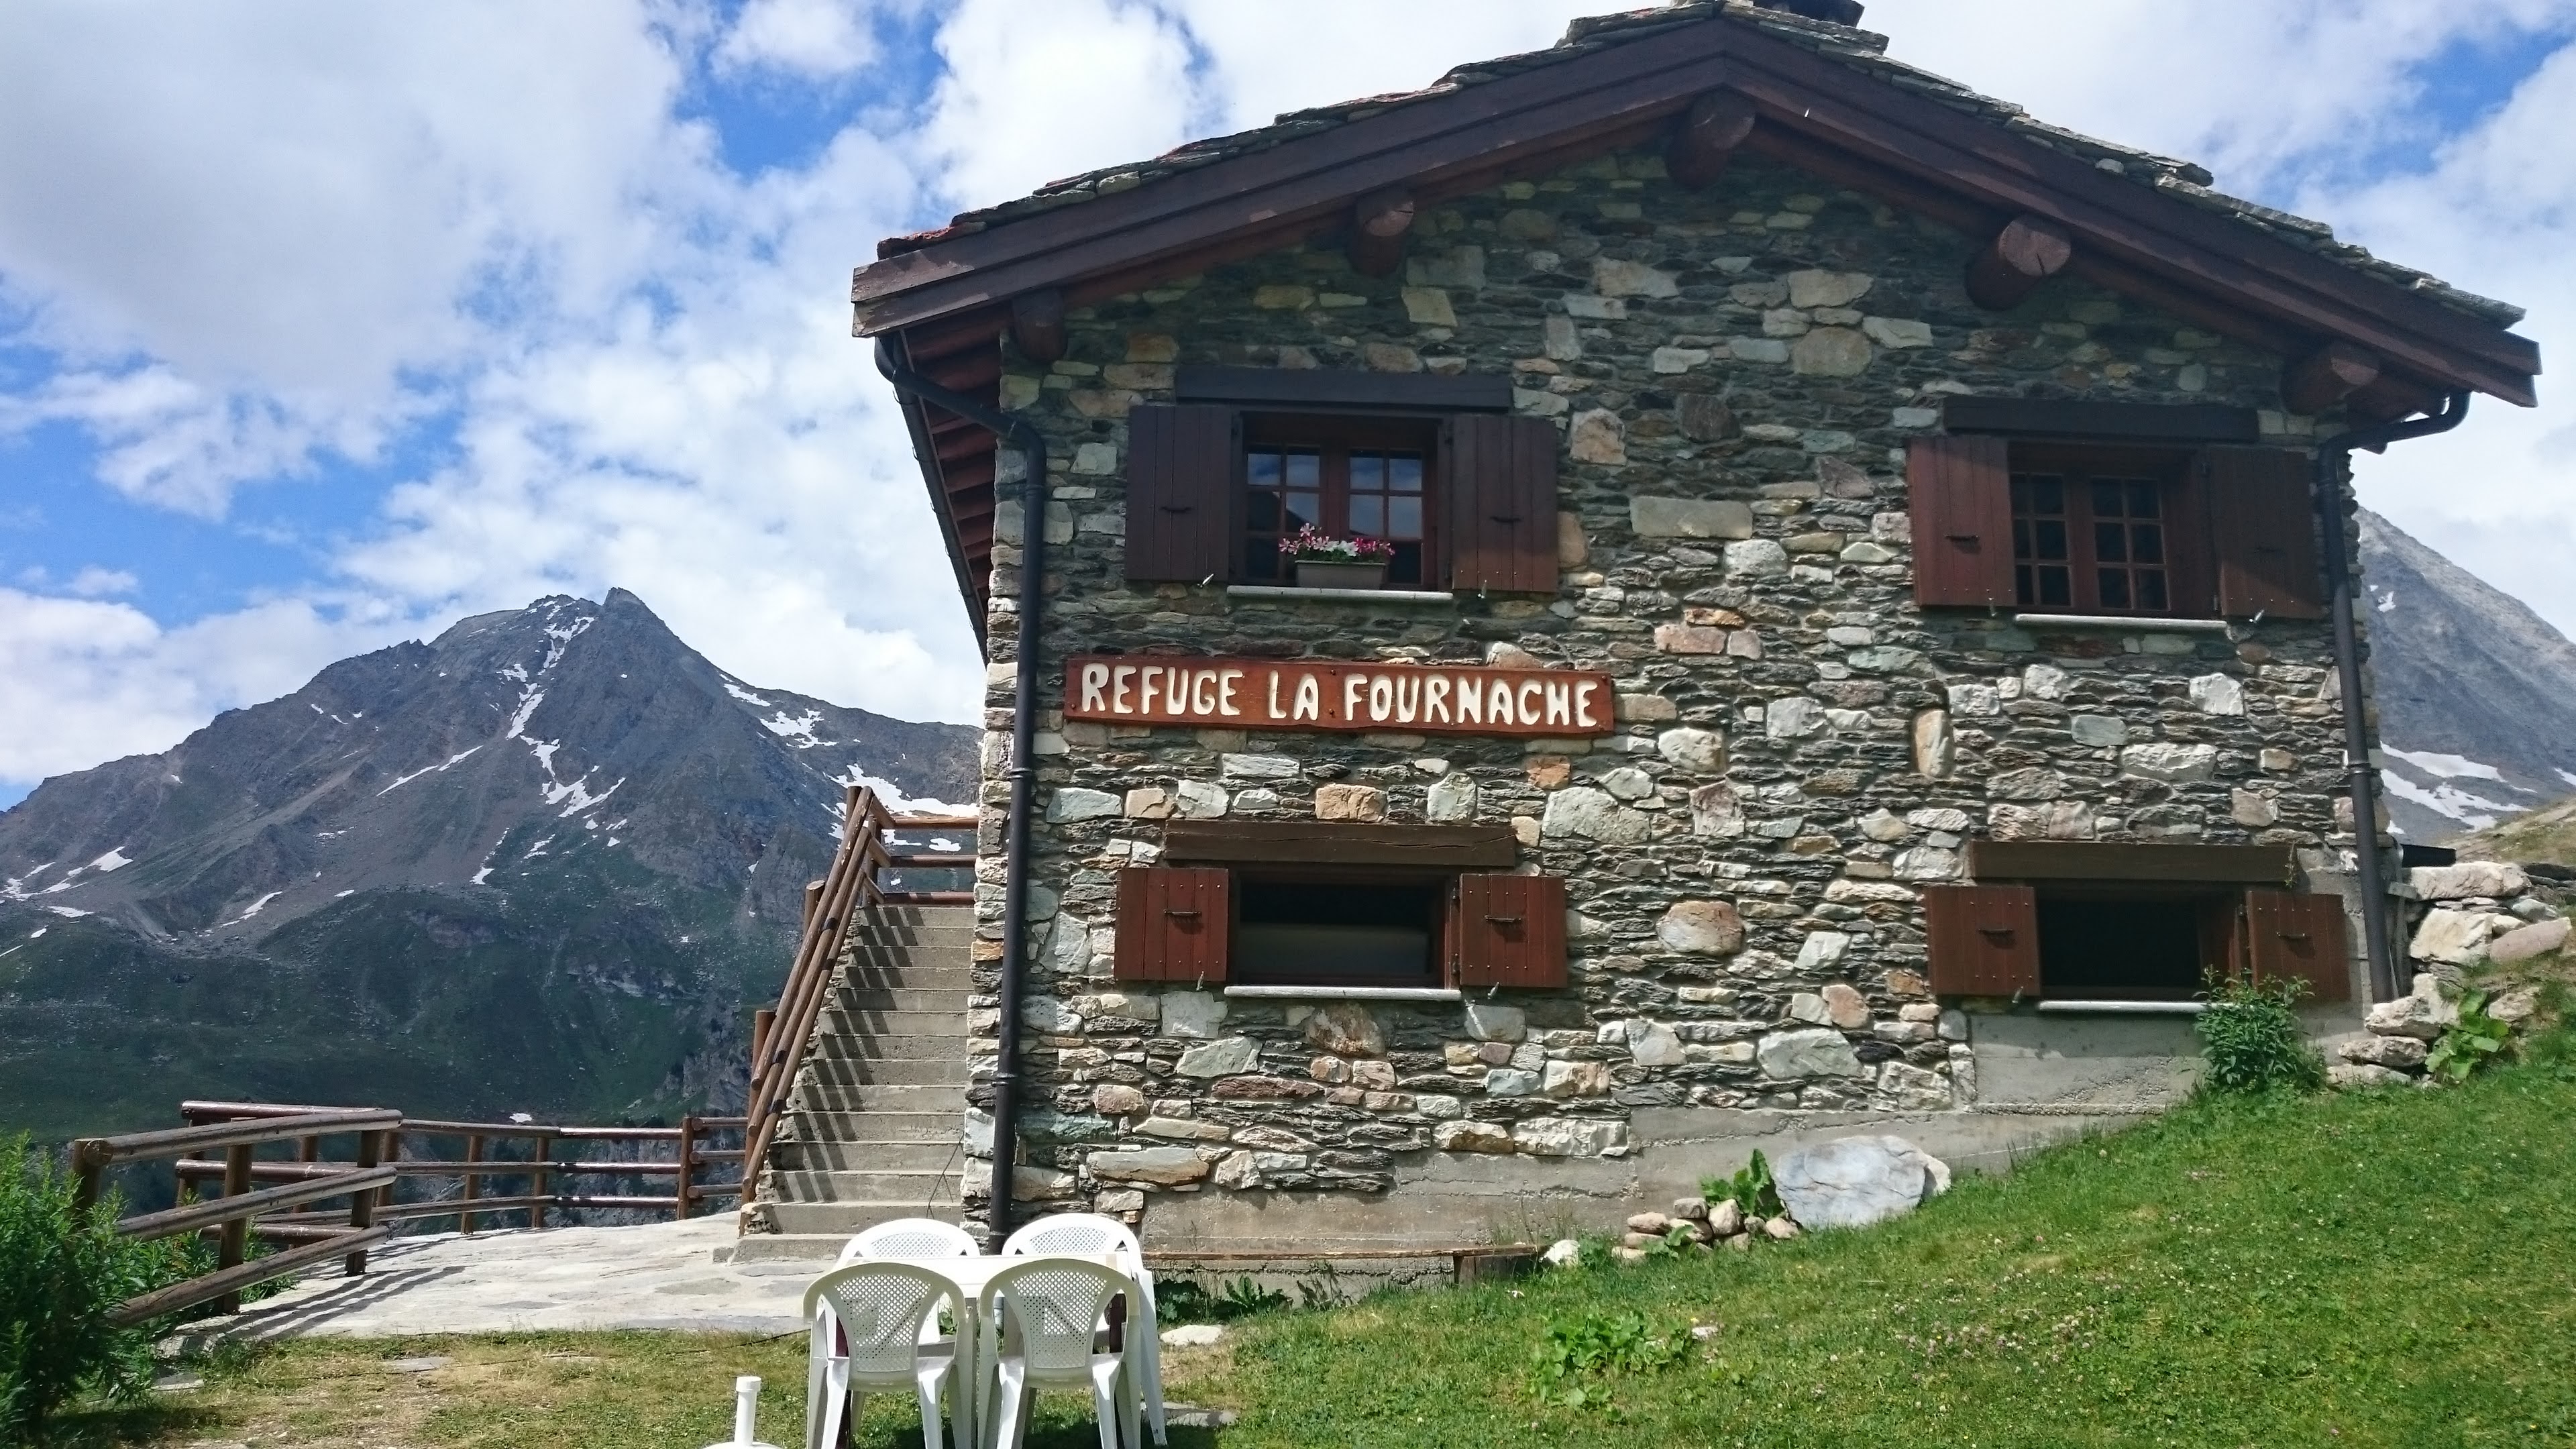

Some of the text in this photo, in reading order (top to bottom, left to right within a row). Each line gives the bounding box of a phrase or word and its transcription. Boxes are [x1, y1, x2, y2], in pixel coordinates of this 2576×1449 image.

[1081, 663, 1598, 727] REFUGE LA FOURNACHE
